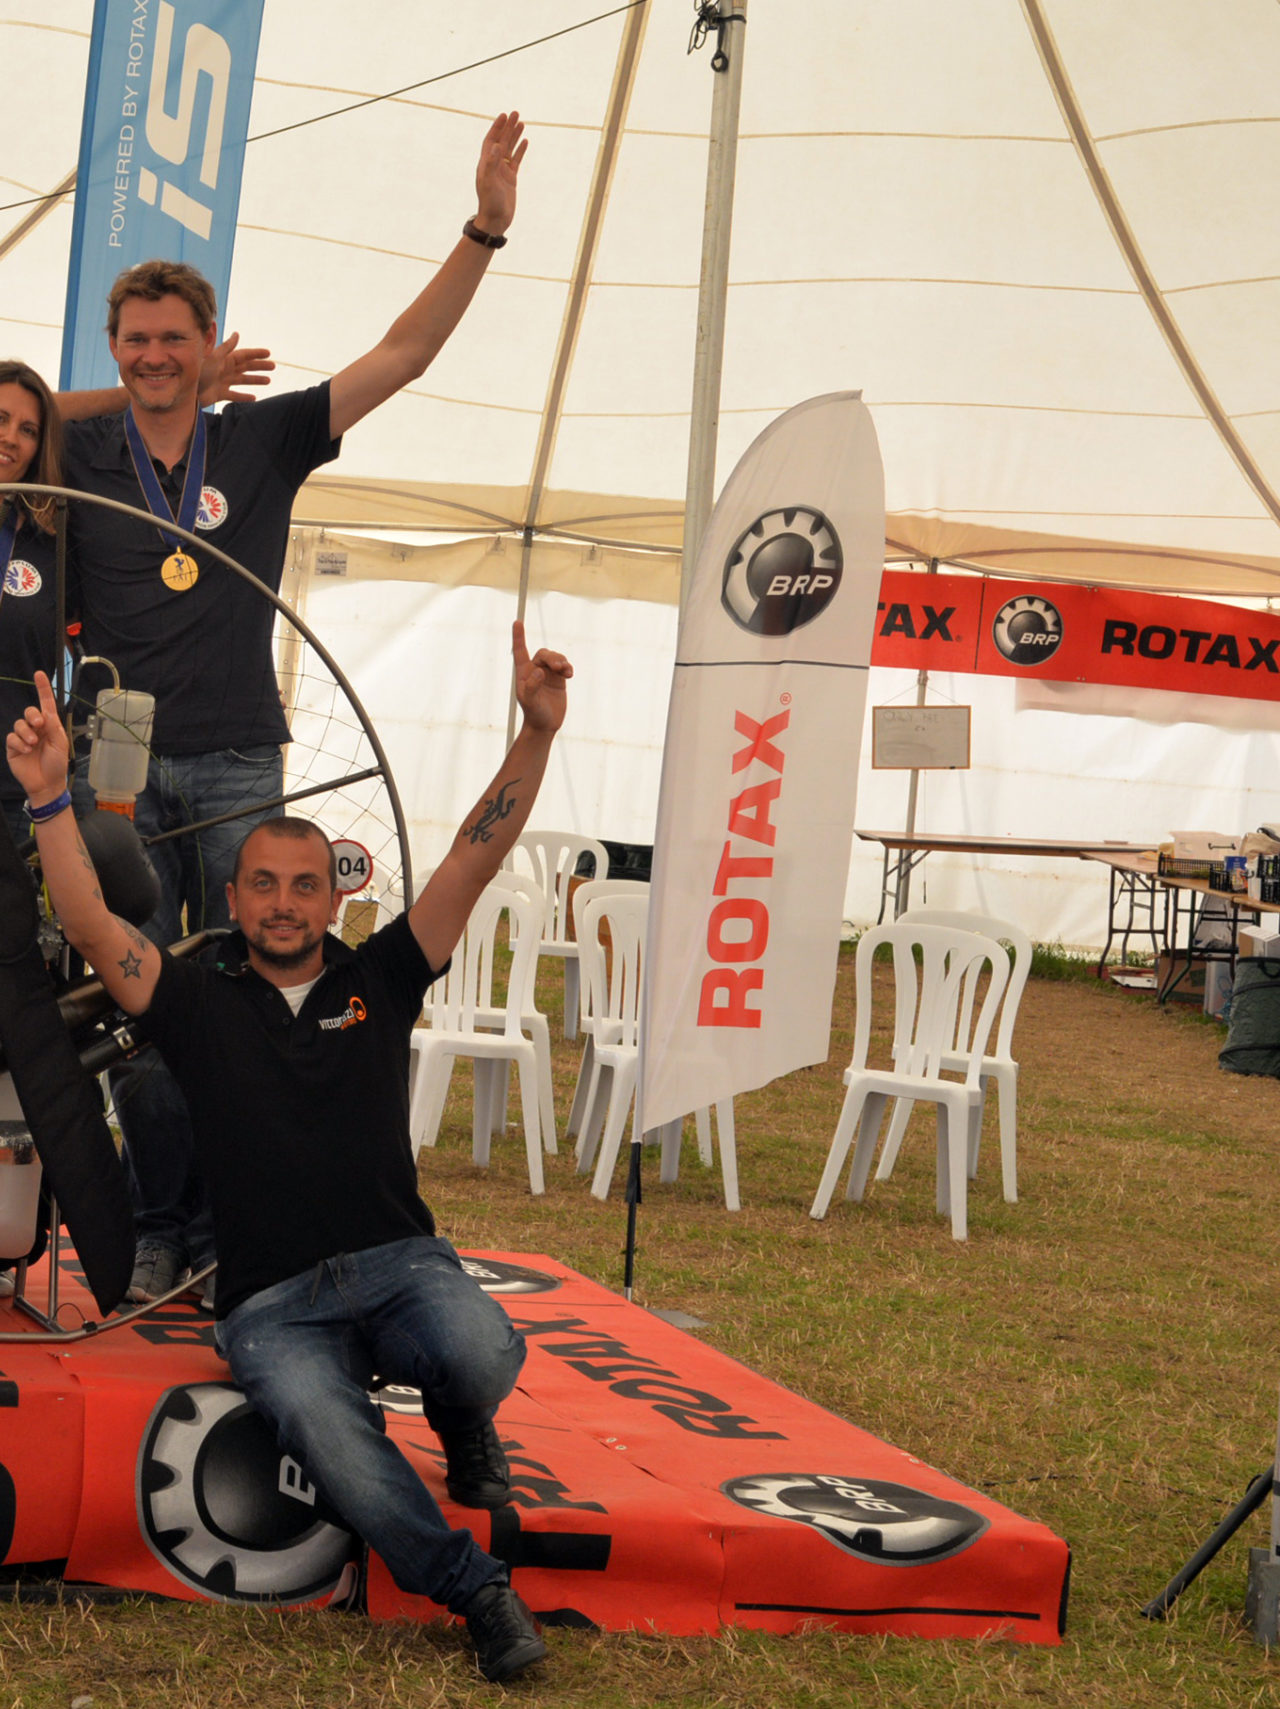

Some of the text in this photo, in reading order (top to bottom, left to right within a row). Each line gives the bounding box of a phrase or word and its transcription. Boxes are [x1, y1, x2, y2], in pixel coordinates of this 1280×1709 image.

[109, 0, 150, 247] POWERED BY ROTAX
[766, 574, 834, 597] BRP
[1019, 632, 1060, 647] BRP
[1100, 619, 1280, 674] ROTAX
[338, 856, 367, 877] 04
[696, 708, 791, 1029] ROTAX
[514, 1317, 790, 1441] ROTAX
[816, 1474, 908, 1515] BRP
